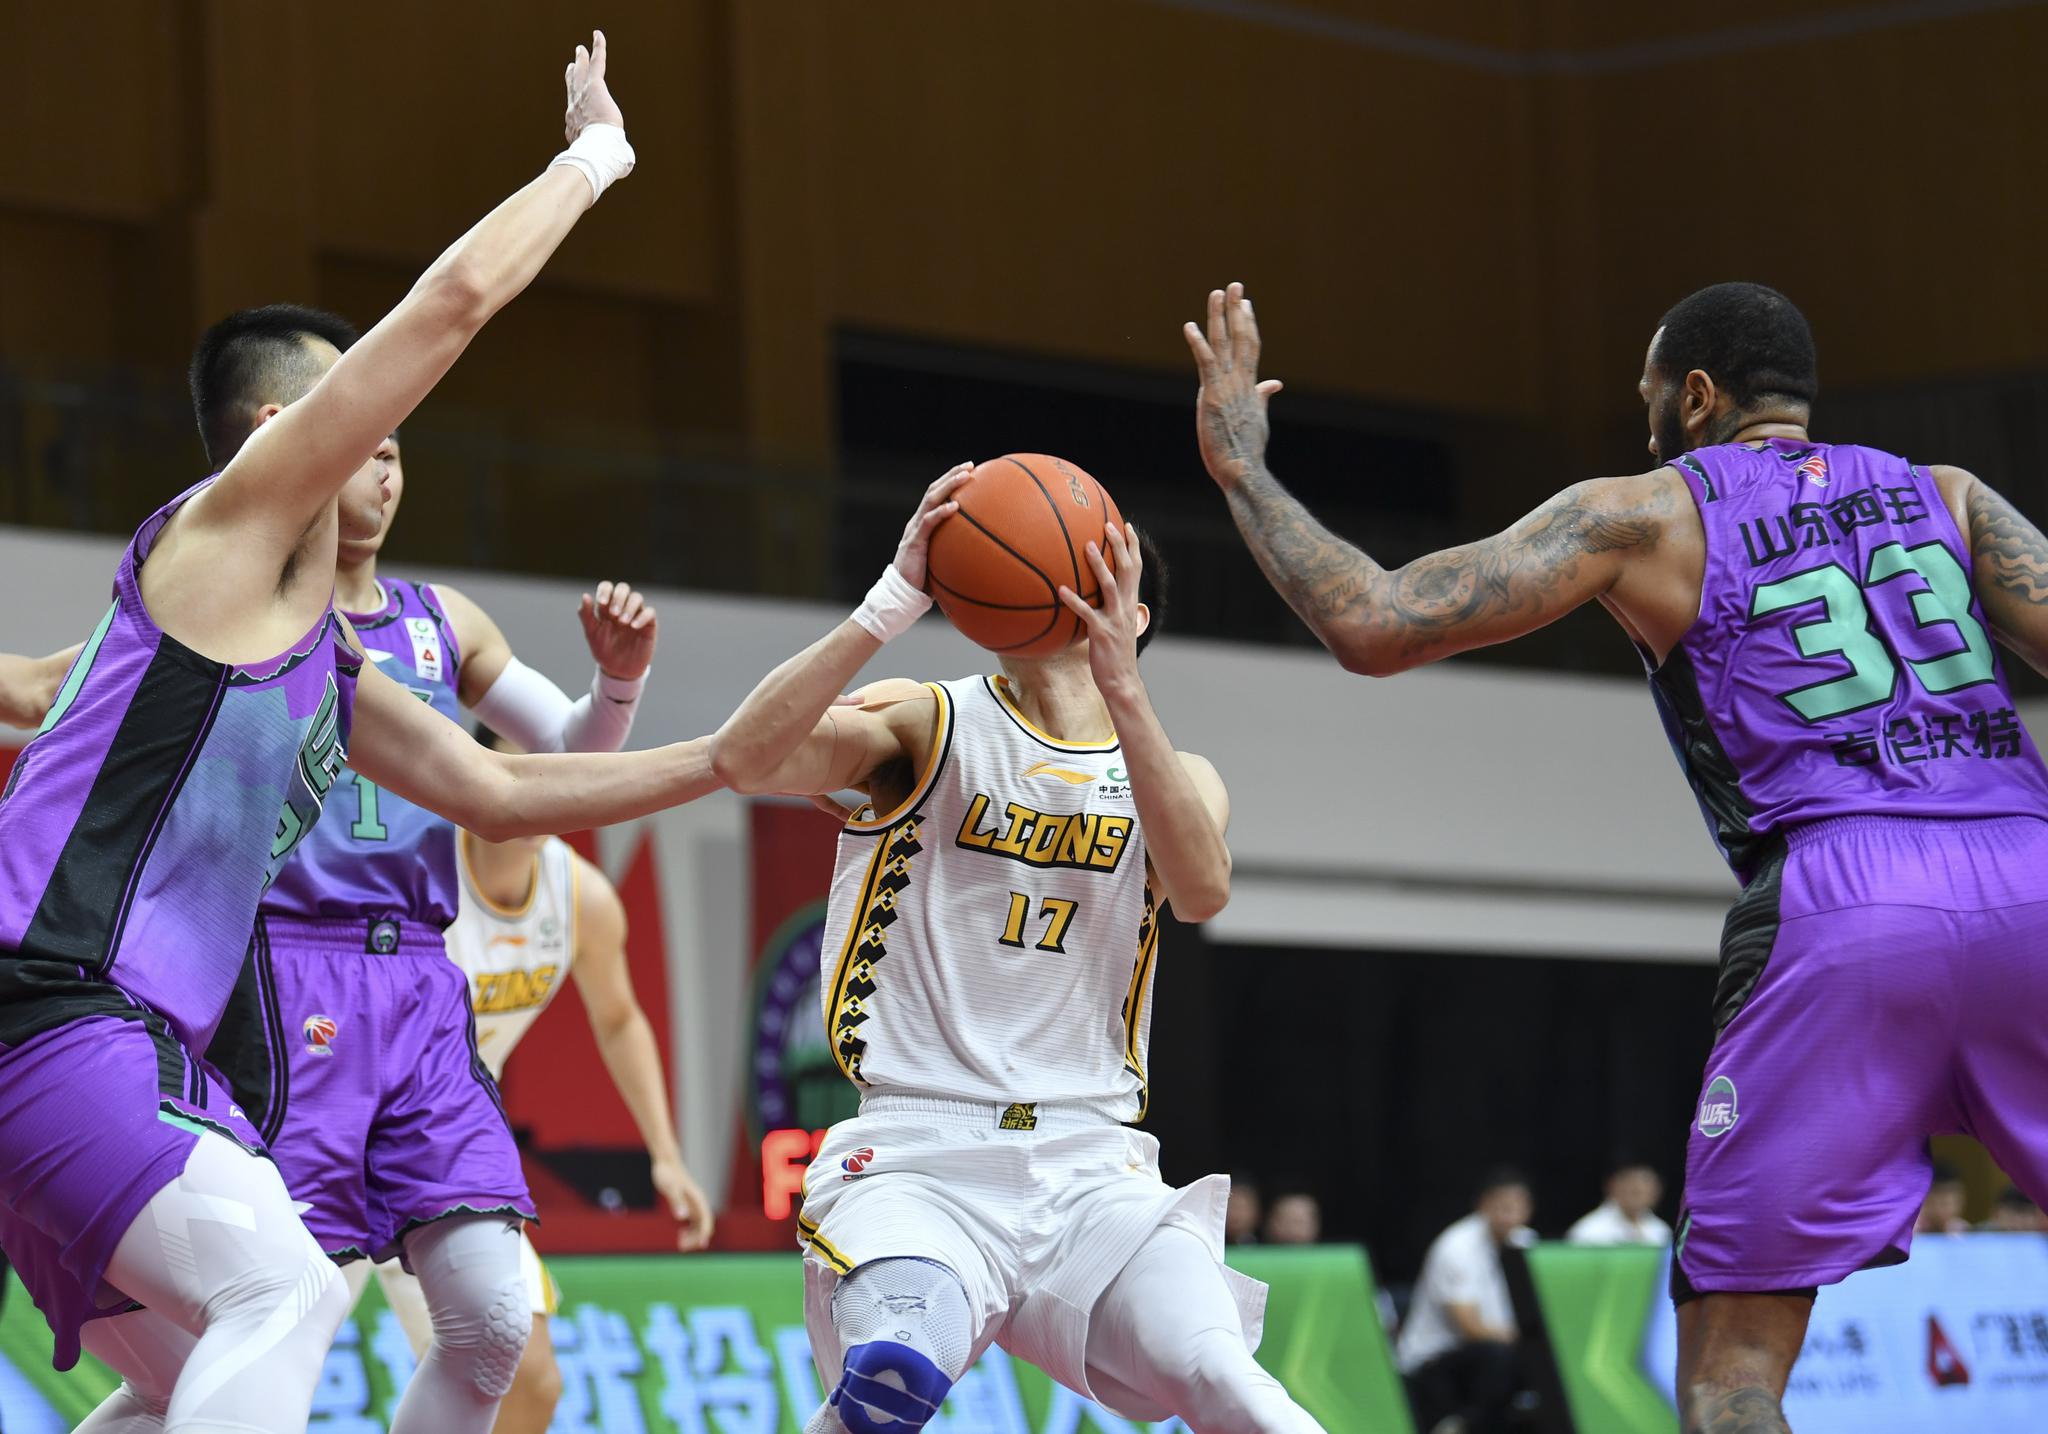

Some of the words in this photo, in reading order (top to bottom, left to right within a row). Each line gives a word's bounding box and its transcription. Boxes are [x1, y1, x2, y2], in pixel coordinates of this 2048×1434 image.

[1739, 484, 1929, 567] 山东西王
[1747, 539, 1996, 723] 33
[1823, 708, 2021, 767] 吉伦沃特
[955, 793, 1134, 873] LIONS
[998, 891, 1079, 954] 17
[1700, 1103, 1733, 1126] 山东
